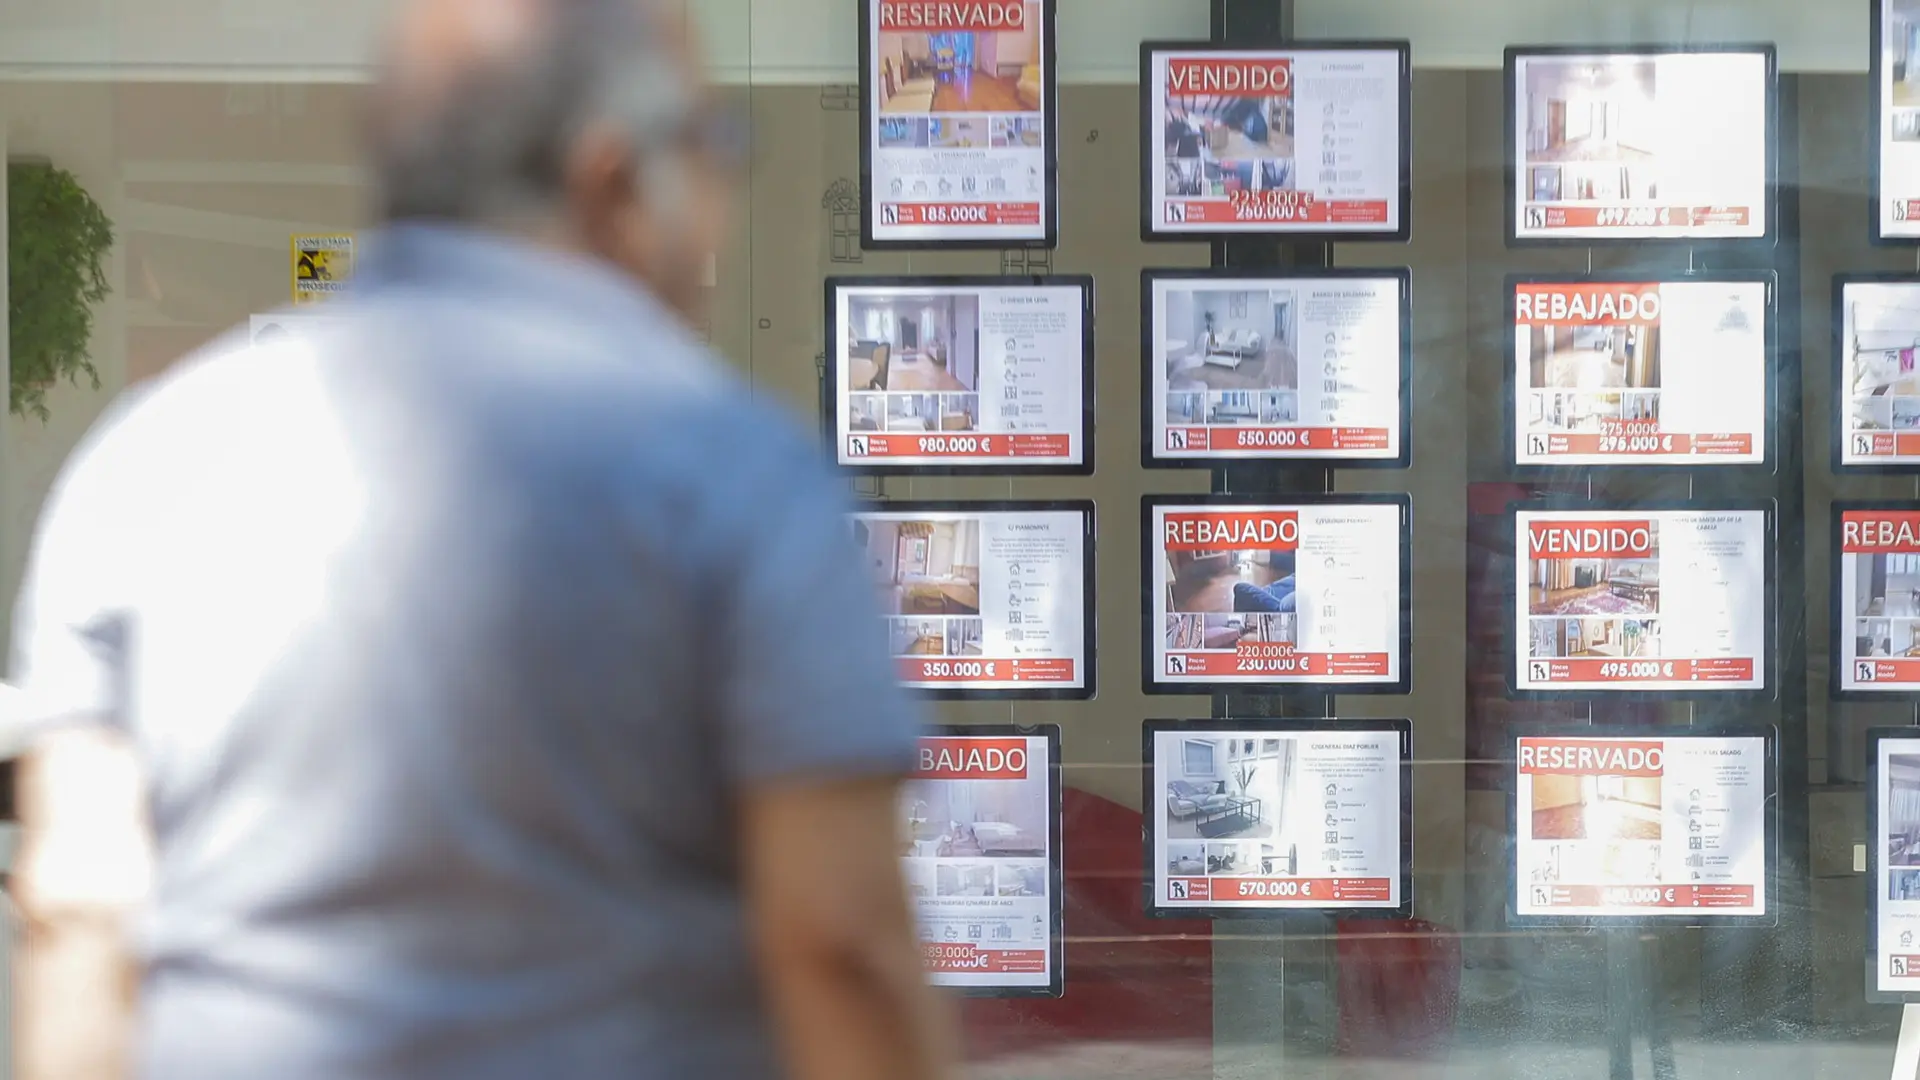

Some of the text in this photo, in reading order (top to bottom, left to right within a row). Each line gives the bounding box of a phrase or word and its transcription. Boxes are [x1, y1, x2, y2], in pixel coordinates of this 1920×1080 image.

[881, 2, 1023, 27] RESERVADO
[1169, 65, 1289, 91] VENDIDO
[297, 282, 345, 291] PROSEGU
[1517, 292, 1661, 321] REBAJADO
[918, 437, 991, 452] 980.000 €
[1237, 430, 1310, 446] 550.000 €
[1165, 519, 1298, 544] REBAJADO
[1529, 528, 1649, 553] VENDIDO
[1236, 645, 1294, 658] 220.000€
[923, 662, 995, 676] 350.000 €
[1299, 657, 1309, 671] €
[1600, 662, 1659, 677] 495.000
[919, 748, 1027, 772] BAJADO
[1521, 746, 1664, 771] RESERVADO
[1239, 881, 1311, 896] 570.000 €
[1664, 888, 1675, 902] €
